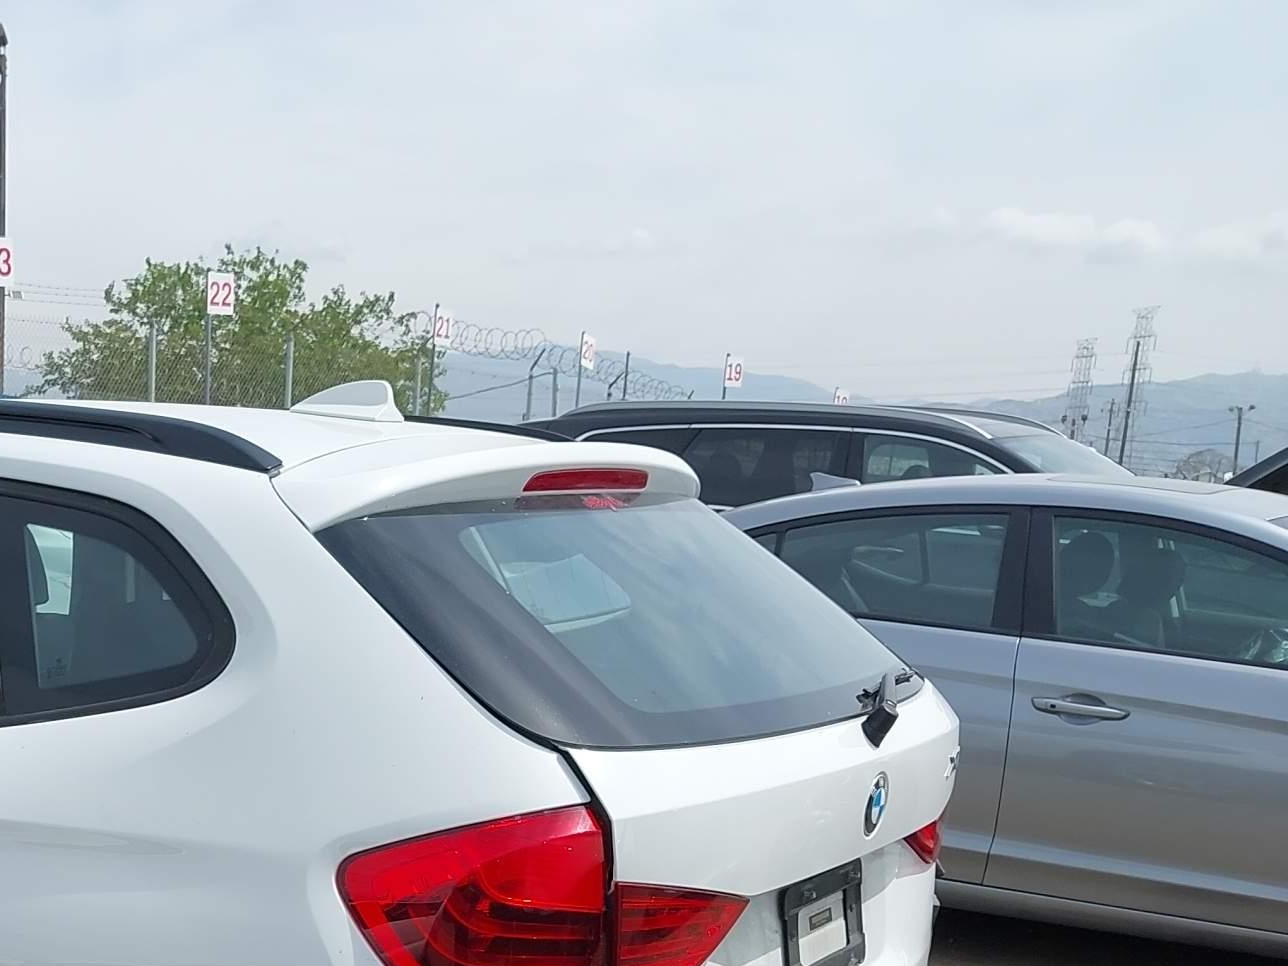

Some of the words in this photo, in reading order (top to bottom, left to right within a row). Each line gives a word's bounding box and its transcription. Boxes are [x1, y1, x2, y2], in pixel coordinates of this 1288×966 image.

[209, 281, 233, 308] 22
[435, 315, 451, 340] 21
[727, 363, 743, 382] 19
